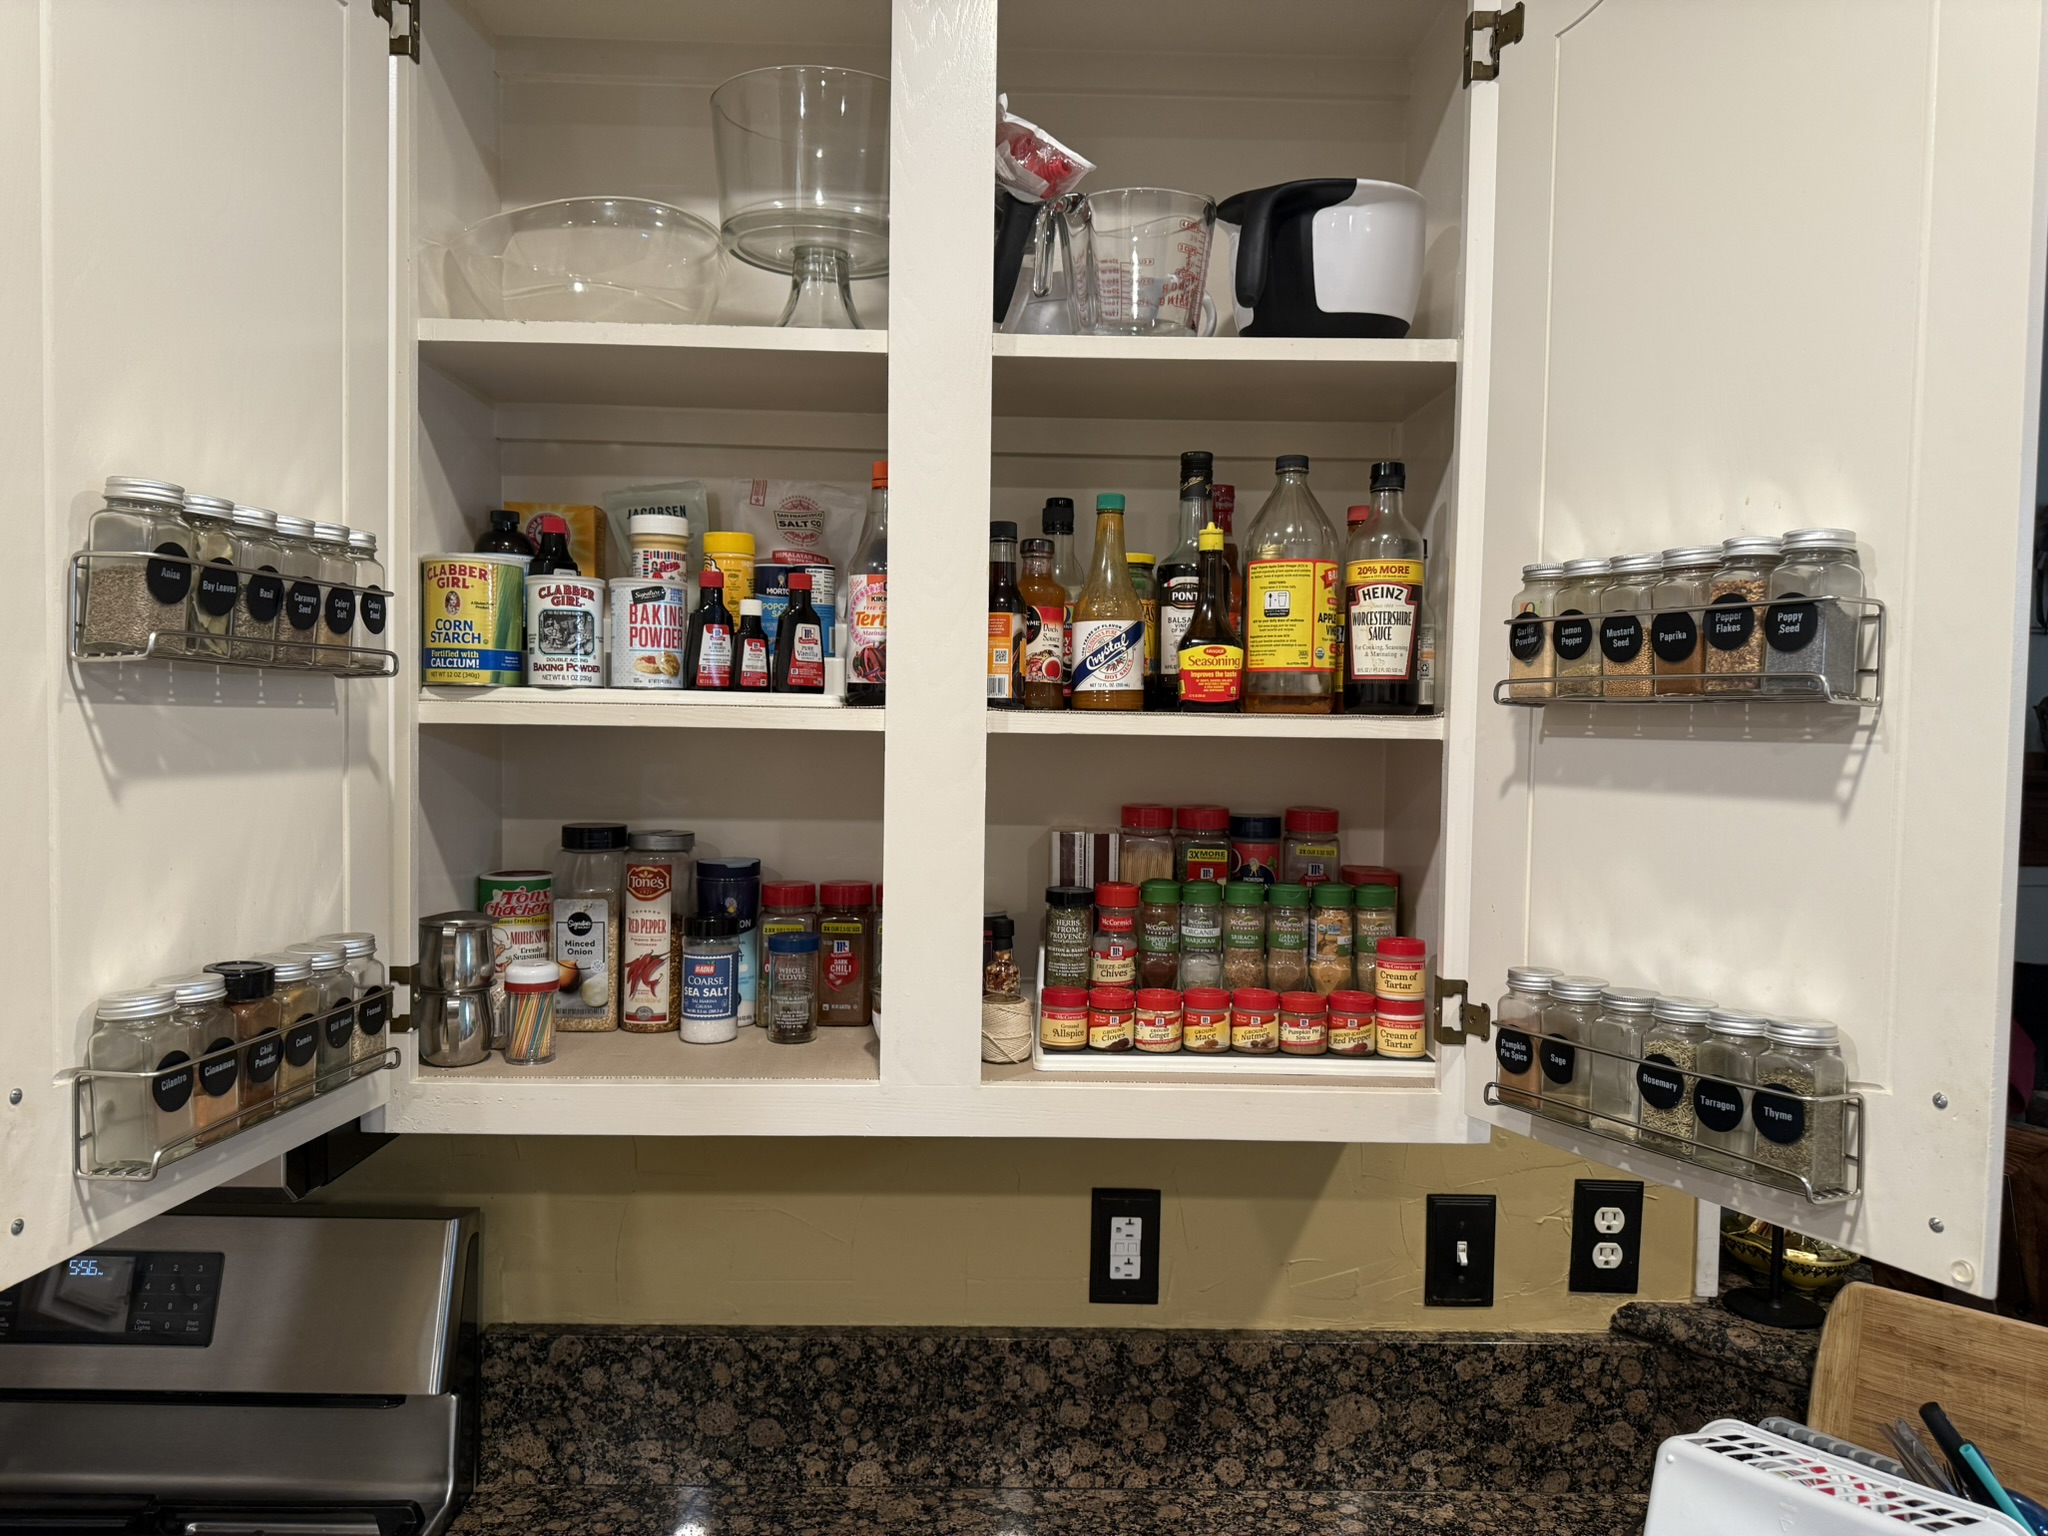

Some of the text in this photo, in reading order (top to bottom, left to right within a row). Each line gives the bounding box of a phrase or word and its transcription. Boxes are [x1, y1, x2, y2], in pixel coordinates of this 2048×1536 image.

[161, 567, 180, 579] Anise
[427, 564, 488, 581] CLABBER
[1358, 566, 1410, 575] 20% MORE
[203, 580, 236, 593] Bay Leaves
[437, 577, 470, 589] GIRL
[260, 588, 273, 598] Basil
[538, 585, 595, 601] CLABBER
[635, 590, 660, 600] Signature
[1362, 587, 1404, 601] HEINZ
[294, 593, 317, 605] Caraway
[335, 599, 350, 609] Celery
[551, 596, 582, 607] GIRL
[299, 605, 311, 614] Seed
[368, 600, 381, 610] Celery
[370, 611, 380, 619] Seed
[629, 603, 683, 627] BAKING
[1352, 611, 1412, 626] WORCESTERSHIRE
[1716, 612, 1742, 623] Pepper
[1778, 612, 1803, 623] Poppy
[435, 619, 473, 631] CORN
[1043, 624, 1058, 632] Duck
[1716, 624, 1741, 633] Flakes
[1779, 624, 1800, 633] Seed
[1368, 627, 1392, 640] SAUCE
[1517, 626, 1534, 636] Garlic
[1562, 627, 1581, 635] Lemon
[1606, 626, 1635, 638] Mustard
[1660, 631, 1686, 642] Paprika
[431, 631, 481, 644] STARCH
[629, 626, 682, 650] POWDER
[1043, 633, 1059, 642] Sauce
[1515, 636, 1537, 646] Powder
[1561, 636, 1582, 646] Pepper
[1613, 638, 1630, 648] Seed
[1086, 633, 1129, 670] Crystal
[431, 658, 479, 668] CALCIUM!
[1188, 655, 1240, 668] Seasoning
[534, 663, 600, 673] BAKING POWDER
[1188, 850, 1200, 860] 3X
[630, 876, 664, 888] Tone's
[627, 917, 666, 934] RED PEPPER
[1145, 923, 1174, 931] McCormick
[511, 931, 534, 944] MORE
[1050, 932, 1086, 940] PROVENCE
[1100, 969, 1128, 978] Chives
[1380, 971, 1408, 980] Cream
[688, 975, 724, 985] COARSE
[1385, 980, 1412, 989] Tartar
[685, 987, 728, 997] SEA SALT
[367, 1004, 381, 1016] Fennel
[330, 1022, 339, 1032] Dill
[1053, 1029, 1084, 1039] Allspice
[1102, 1033, 1126, 1042] Cloves
[1241, 1032, 1270, 1040] Nutmeg
[1348, 1033, 1371, 1043] Pepper
[1380, 1030, 1408, 1040] Cream
[296, 1034, 312, 1047] Cumin
[1385, 1040, 1412, 1048] Tartar
[1501, 1039, 1527, 1051] Pumpkin
[260, 1043, 273, 1056] Chili
[1501, 1048, 1528, 1062] Pie Spice
[255, 1054, 277, 1068] Powder
[1550, 1053, 1566, 1066] Sage
[204, 1059, 236, 1076] Cinnamon
[161, 1074, 187, 1091] Cilantro
[1642, 1073, 1678, 1092] Rosemary
[1700, 1095, 1736, 1111] Tarragon
[1763, 1106, 1792, 1121] Thyme
